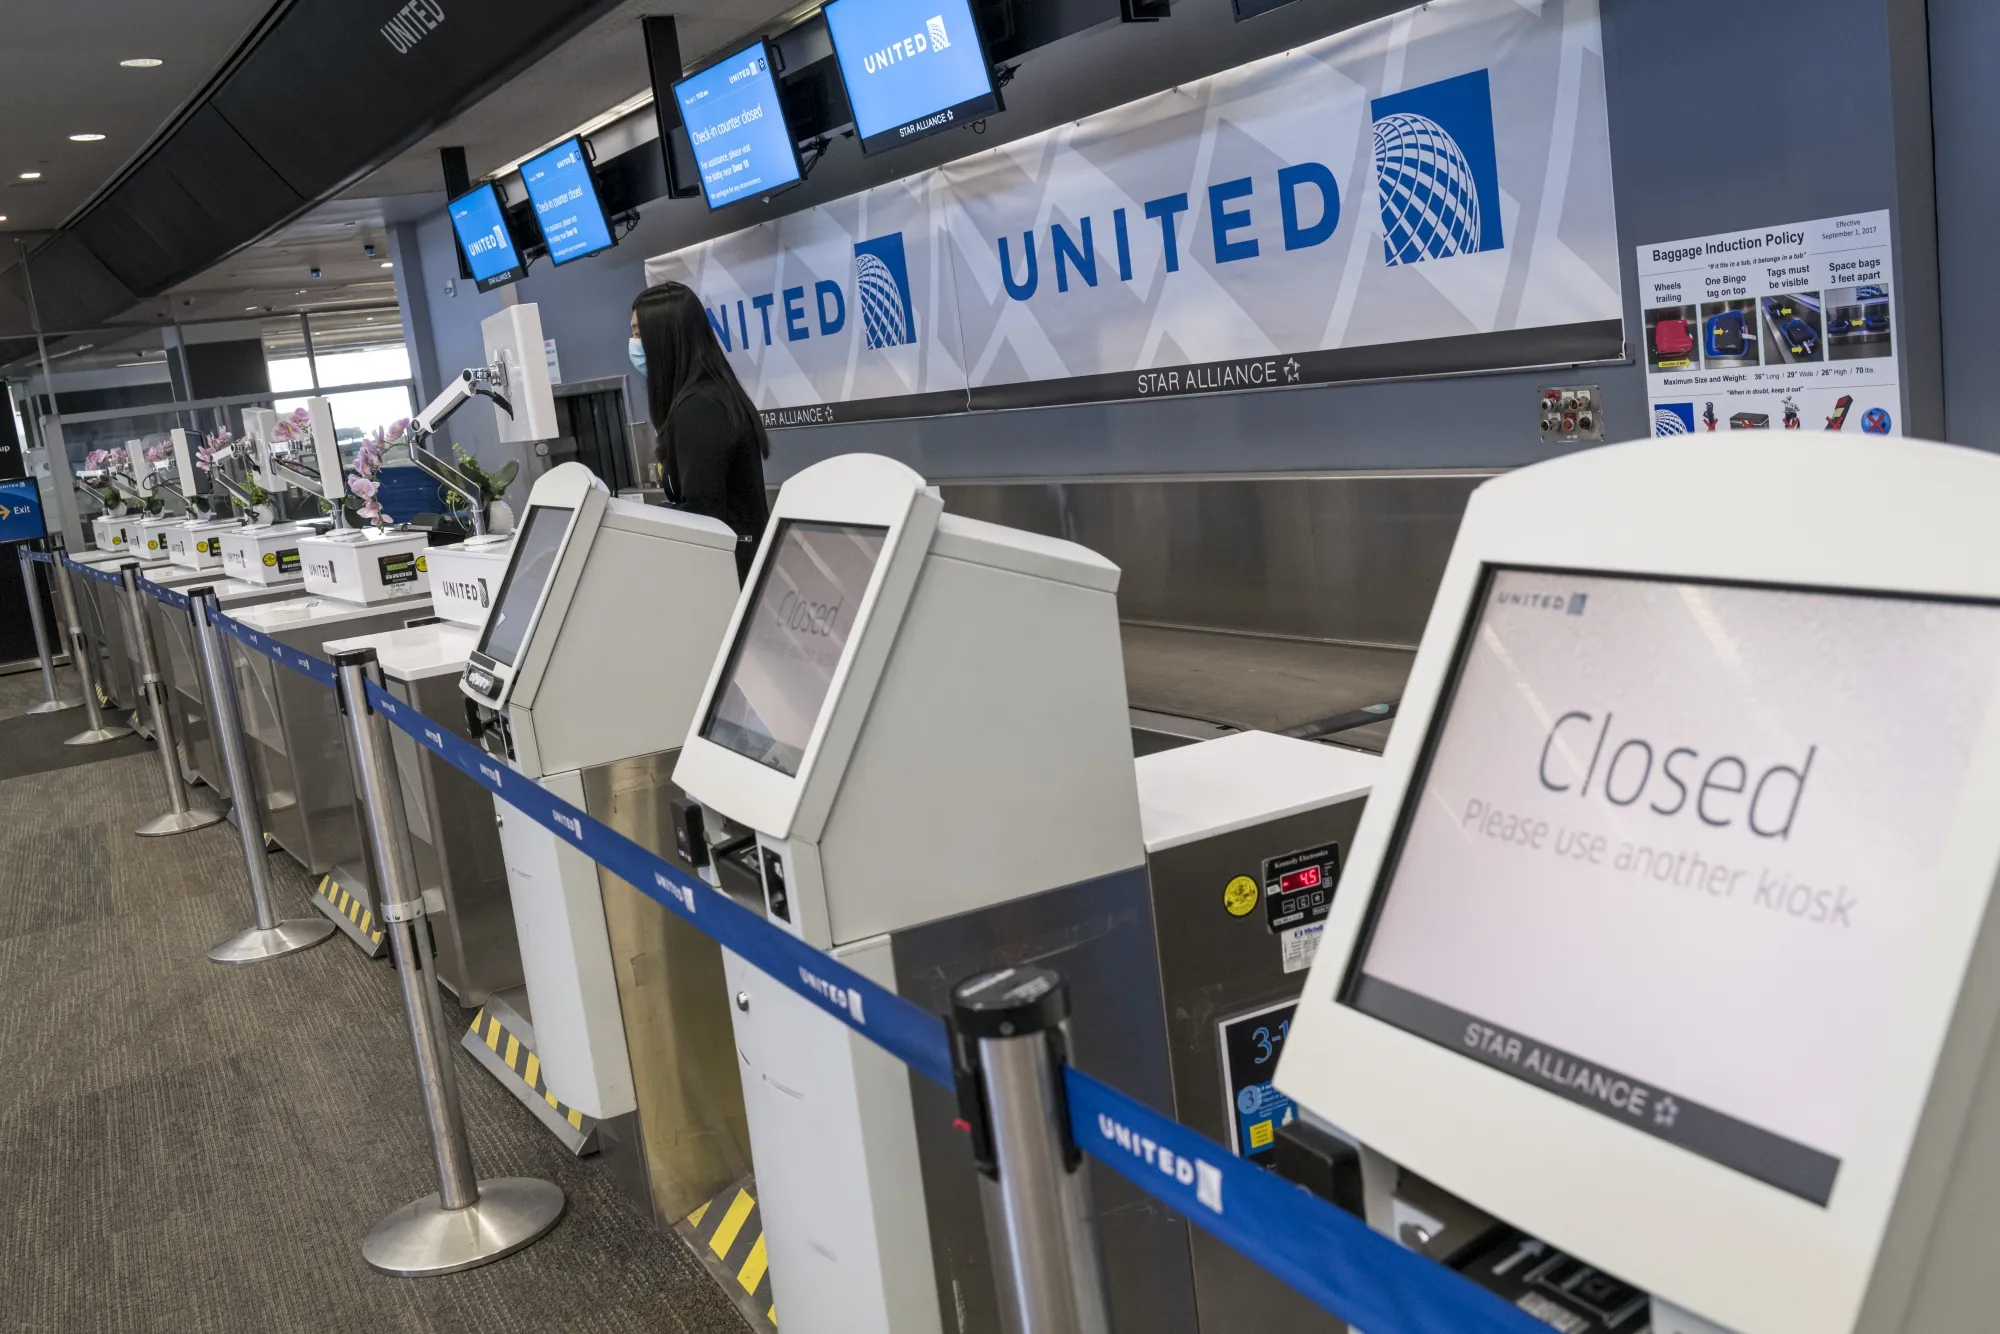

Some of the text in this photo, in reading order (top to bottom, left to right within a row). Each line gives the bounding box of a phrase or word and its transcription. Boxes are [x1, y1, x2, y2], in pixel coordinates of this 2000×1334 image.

[380, 0, 445, 54] UNITED
[864, 33, 928, 74] UNITED
[729, 69, 751, 84] UNITED
[692, 103, 763, 145] Check-in counter closed
[900, 113, 947, 138] STAR ALLIANCE
[998, 162, 1340, 301] UNITED
[1836, 220, 1860, 228] Effective
[1822, 229, 1853, 240] September
[468, 234, 497, 257] UNITED
[1653, 231, 1804, 262] Baggage Induction Policy
[1767, 265, 1810, 278] Tags must
[1829, 258, 1880, 272] Space bags
[1654, 282, 1681, 292] Wheels
[1705, 275, 1746, 286] One Bingo
[1769, 277, 1809, 289] be visible
[1830, 271, 1880, 284] 3 feet apart
[1656, 294, 1682, 303] trailing
[1707, 289, 1719, 298] tag
[1733, 287, 1746, 295] top
[706, 280, 846, 352] NITED
[1138, 361, 1277, 394] STAR ALLIANCE
[1664, 376, 1693, 385] Maximum
[760, 408, 823, 426] TAR ALLIANCE
[14, 505, 31, 515] Exit
[308, 563, 330, 578] UNITED
[443, 580, 478, 600] UNITED
[1500, 592, 1564, 611] UNITED
[776, 590, 844, 638] Closed
[1538, 710, 1817, 842] Closed
[552, 809, 575, 831] UNITED
[1274, 850, 1328, 869] Kennedy Electronics
[1462, 797, 1858, 928] Please use another kiosk
[799, 965, 848, 1009] UNITED
[1464, 1023, 1649, 1116] STAR ALLIANCE
[1243, 1090, 1255, 1109] 3
[1098, 1112, 1194, 1186] UNITED
